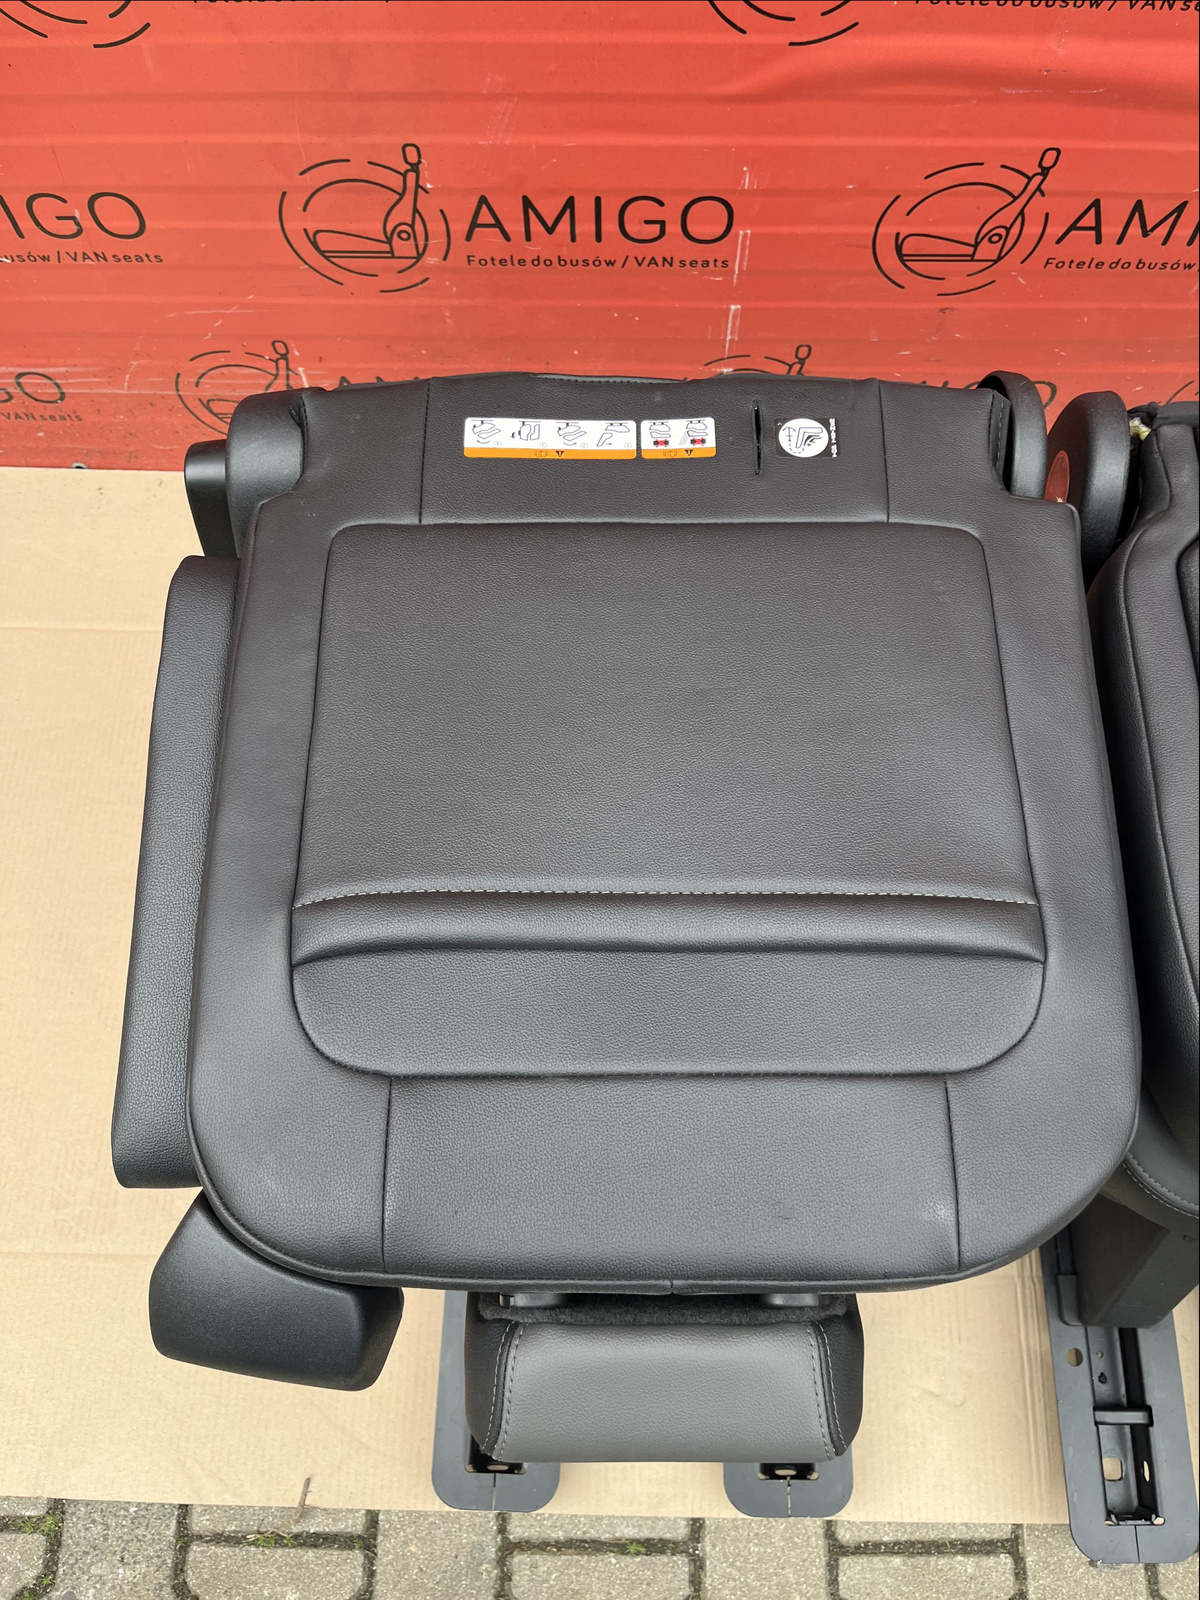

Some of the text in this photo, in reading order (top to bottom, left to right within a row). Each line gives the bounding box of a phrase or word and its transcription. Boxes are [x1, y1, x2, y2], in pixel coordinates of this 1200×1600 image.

[465, 194, 734, 245] AMIGO
[0, 250, 50, 263] usów
[466, 254, 527, 267] Fotele
[531, 254, 552, 268] do
[557, 254, 617, 268] busów
[634, 256, 674, 268] VAN
[678, 256, 730, 269] seats
[1043, 257, 1197, 271] Fotele do busów
